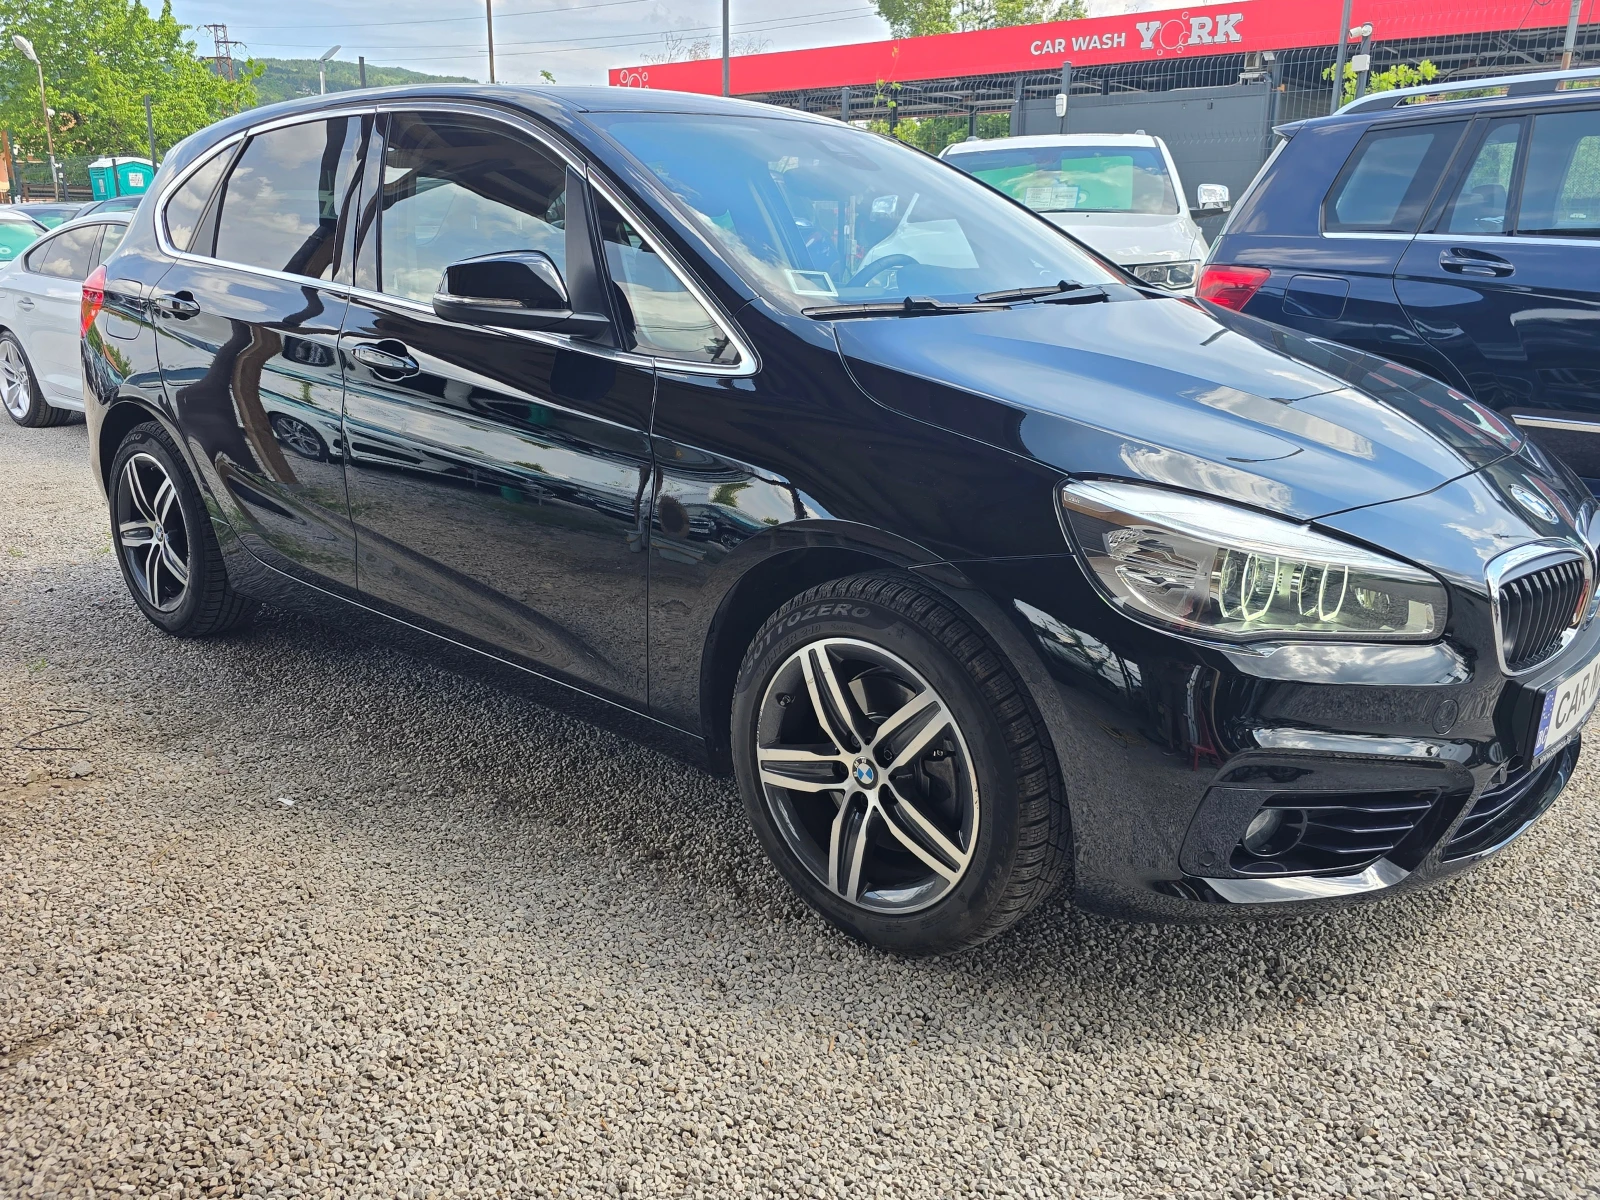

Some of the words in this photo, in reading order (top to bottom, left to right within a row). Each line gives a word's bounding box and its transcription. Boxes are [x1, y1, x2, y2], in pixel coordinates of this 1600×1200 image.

[1030, 40, 1065, 56] CAR
[1072, 32, 1126, 52] WASH
[1136, 13, 1243, 50] YORK
[745, 603, 871, 675] SOTTOZERO
[1555, 672, 1590, 729] CAR
